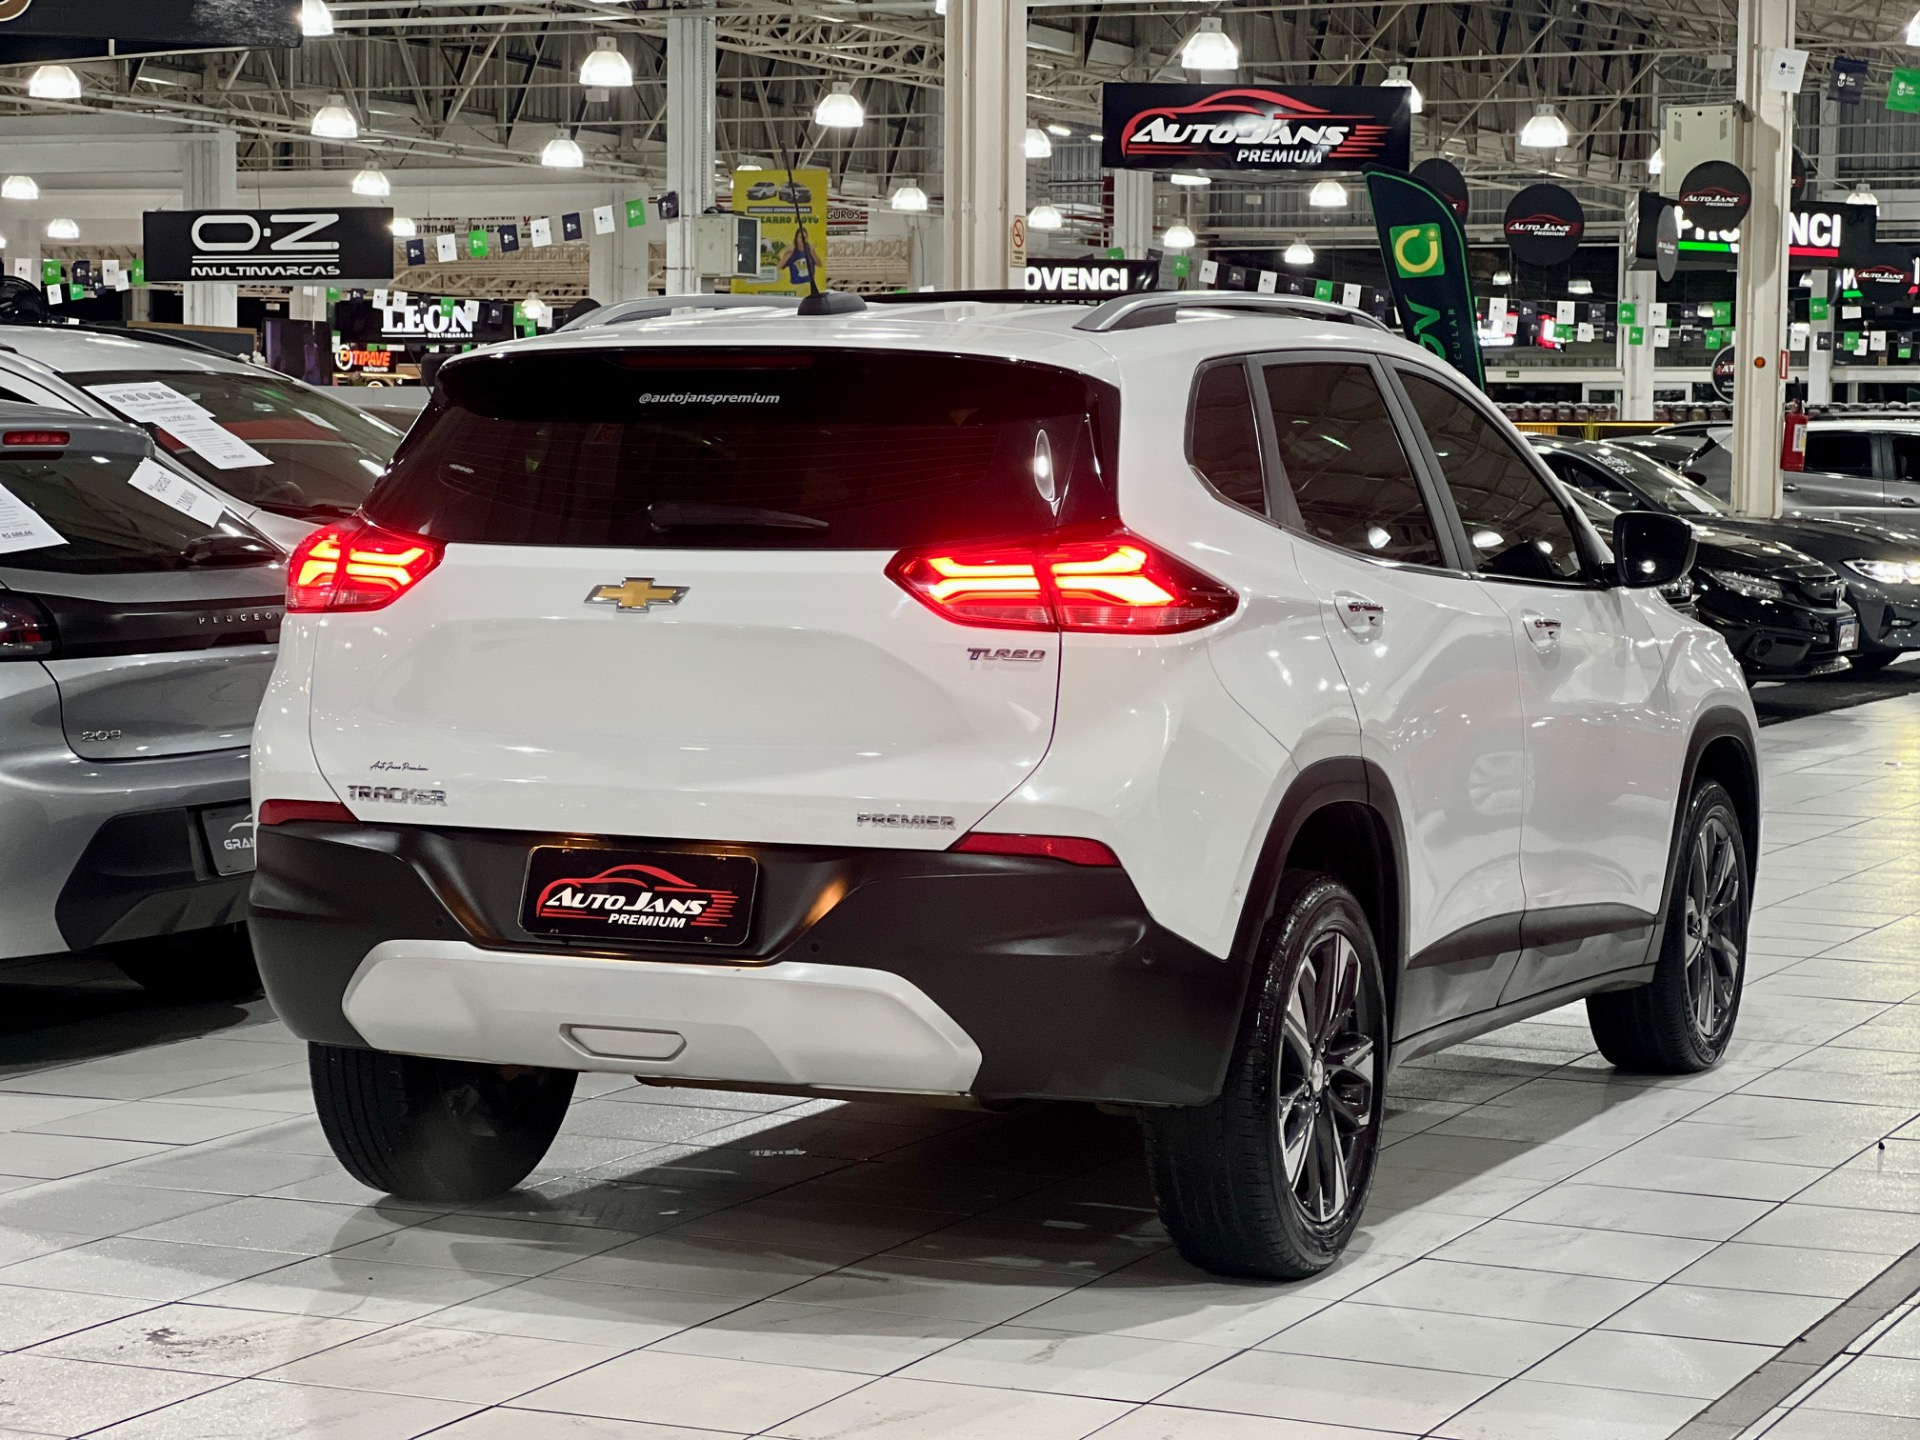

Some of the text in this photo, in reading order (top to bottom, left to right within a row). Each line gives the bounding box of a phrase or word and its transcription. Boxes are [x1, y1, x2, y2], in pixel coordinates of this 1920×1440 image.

[1236, 148, 1322, 164] PREMIUM
[190, 266, 341, 277] MULTIMARCAS
[381, 304, 474, 333] LEON
[639, 392, 780, 405] @autojanspremium
[967, 647, 1046, 662] TURBO
[82, 729, 121, 742] 208
[347, 785, 448, 807] TRACKER
[857, 812, 956, 830] PREMIER
[607, 912, 687, 928] PREMIUM
